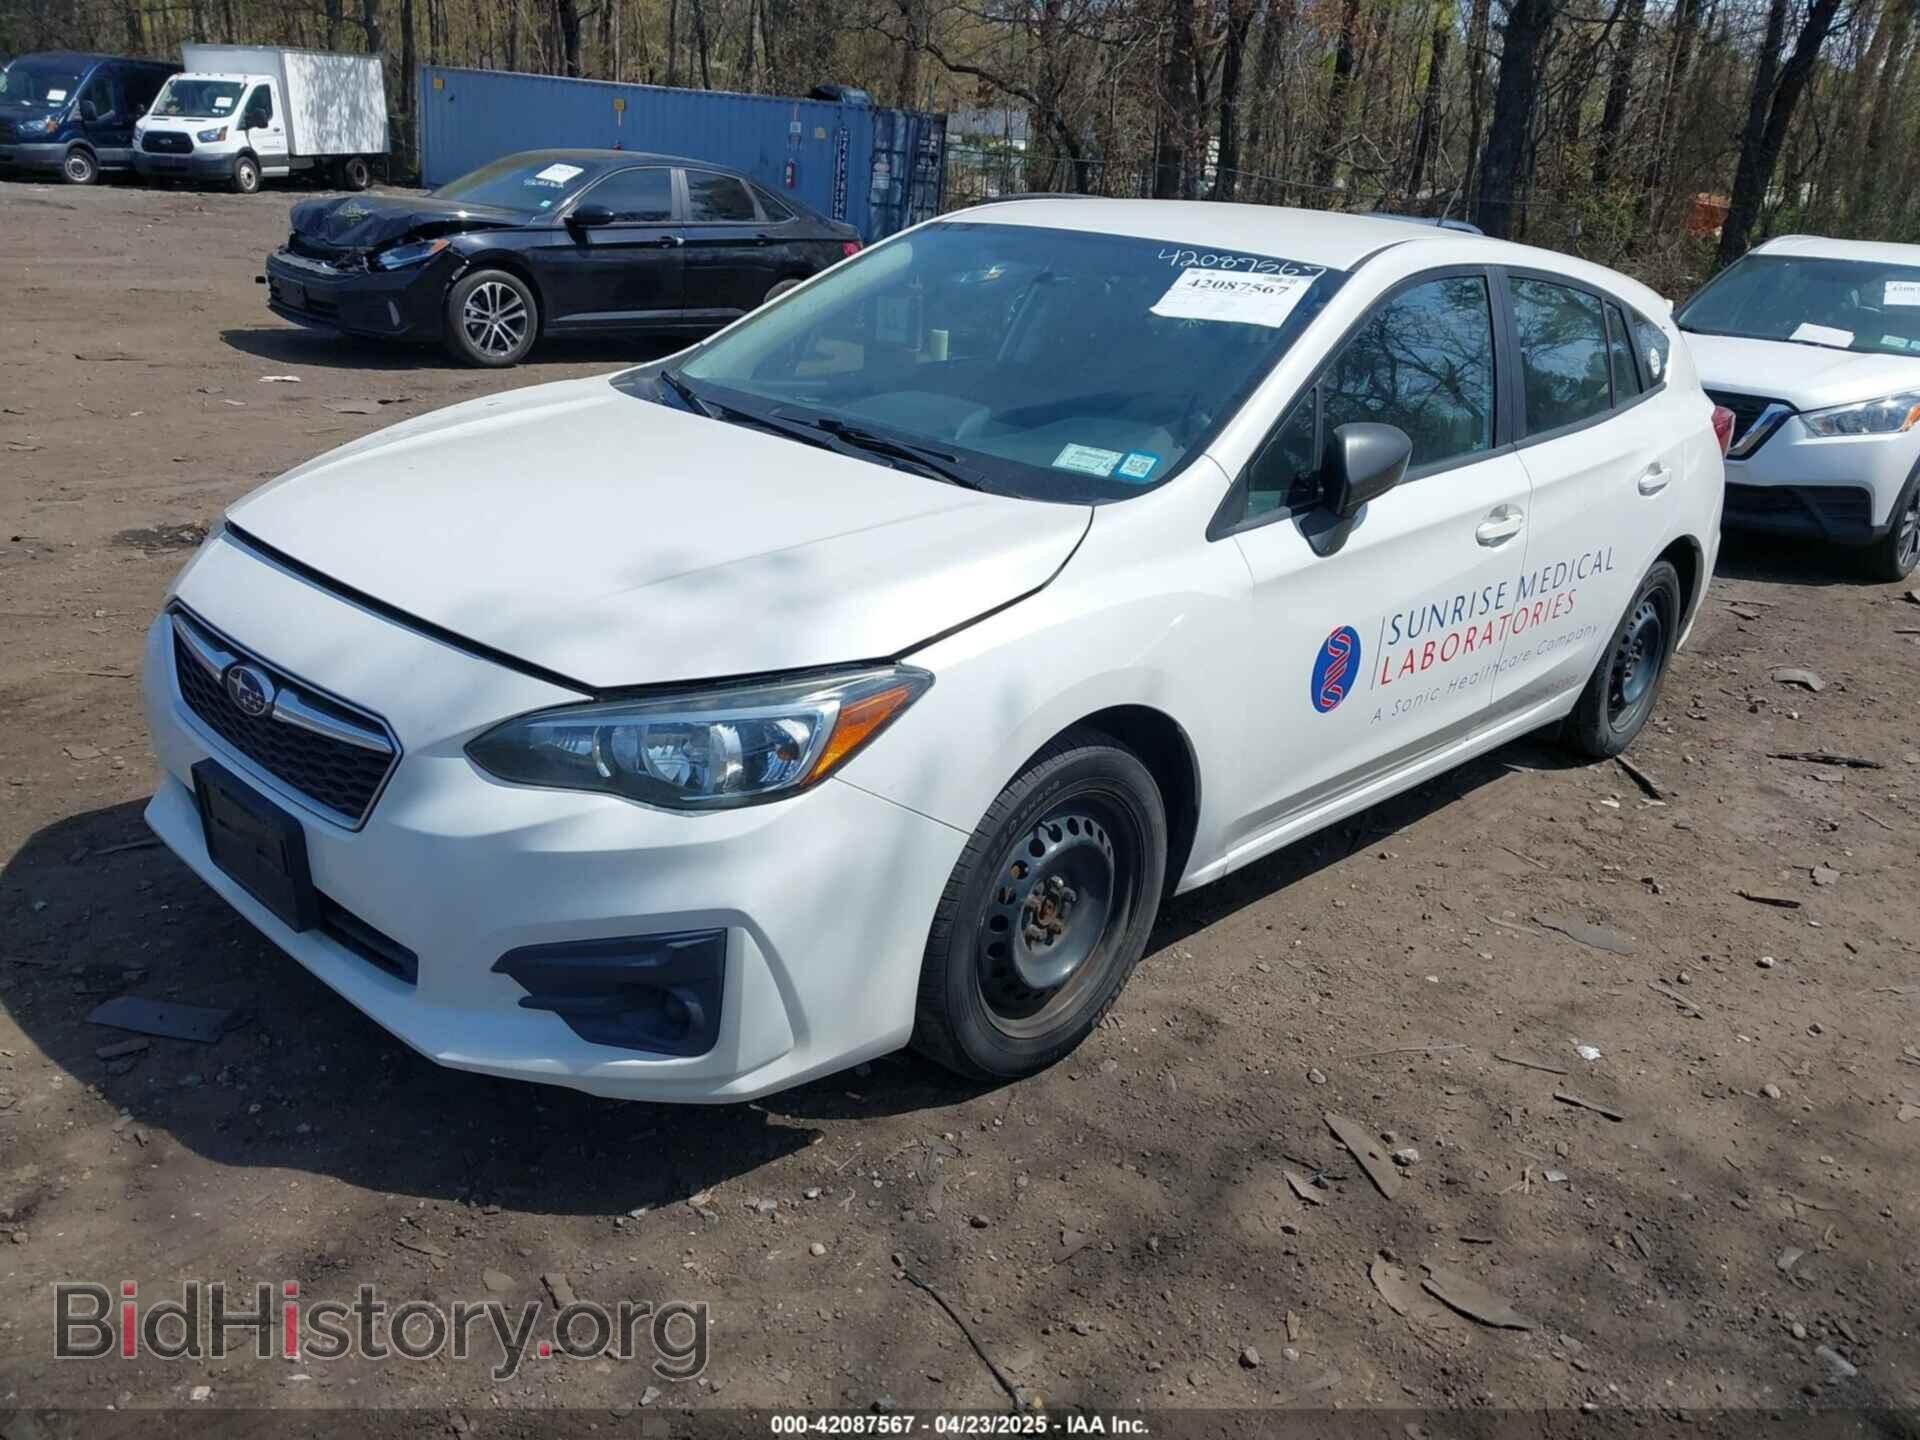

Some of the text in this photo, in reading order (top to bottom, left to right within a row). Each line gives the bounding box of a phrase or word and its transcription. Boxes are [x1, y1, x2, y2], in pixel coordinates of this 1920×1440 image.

[1158, 248, 1327, 281] 42087567
[1187, 278, 1291, 297] 42087567
[1380, 588, 1577, 686] LABORATORIES
[1387, 547, 1615, 646] SUNRISE MEDICAL
[1370, 624, 1599, 725] A Sonic Healthcare Company
